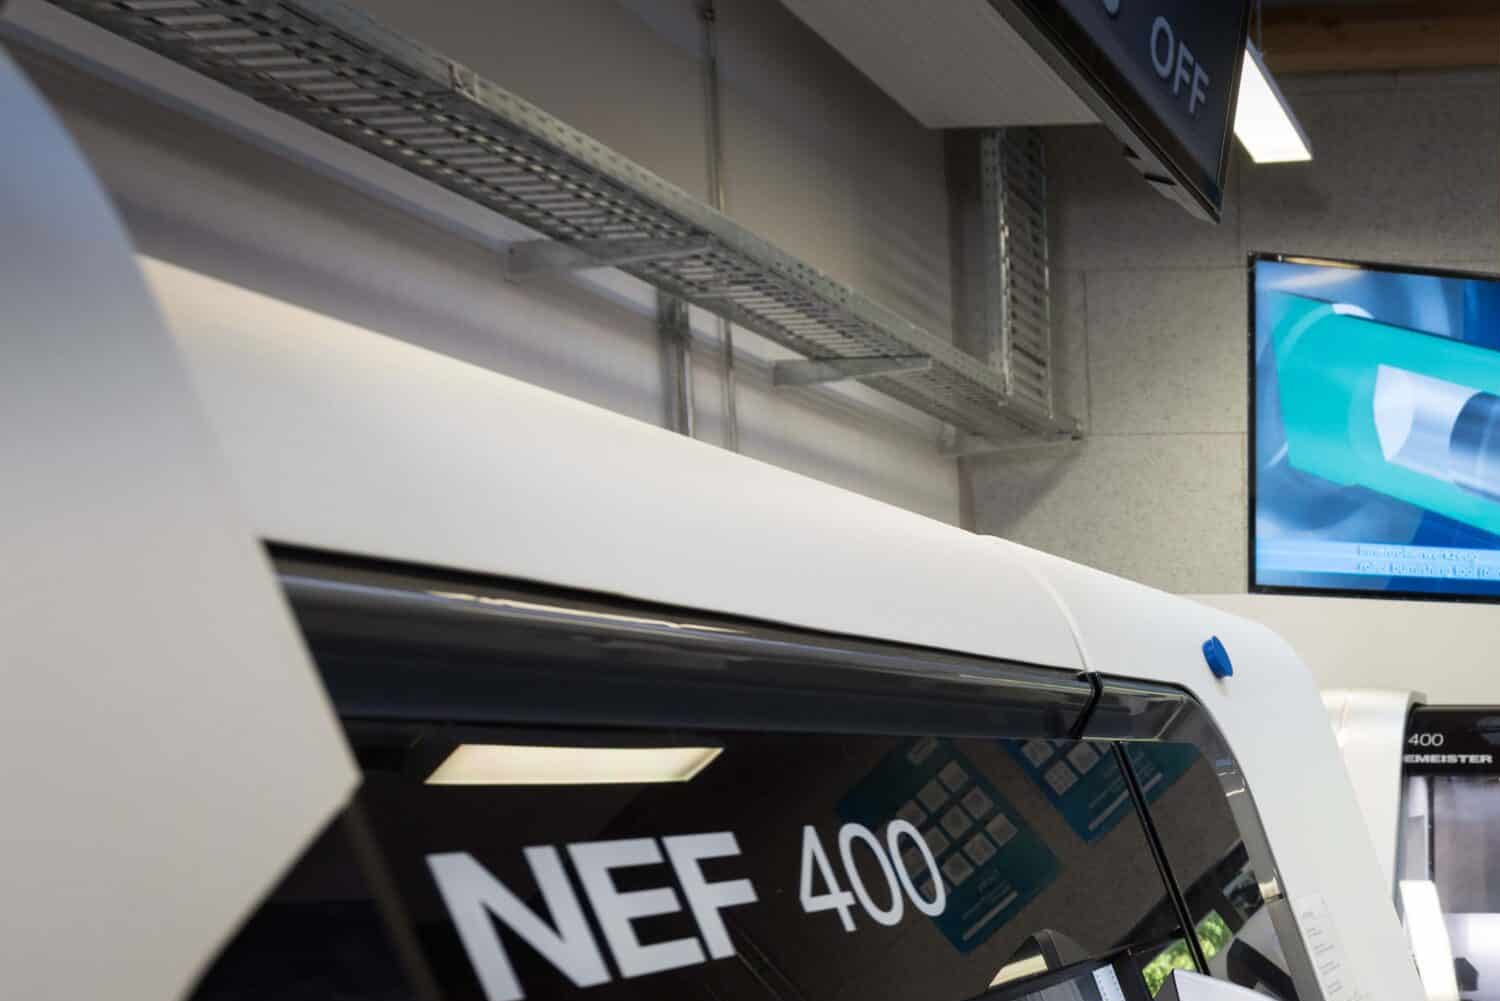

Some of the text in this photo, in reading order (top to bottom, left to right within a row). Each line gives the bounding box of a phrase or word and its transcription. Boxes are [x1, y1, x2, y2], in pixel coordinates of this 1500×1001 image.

[1151, 15, 1209, 113] OFF
[1408, 733, 1444, 746] 400
[799, 819, 947, 933] 400
